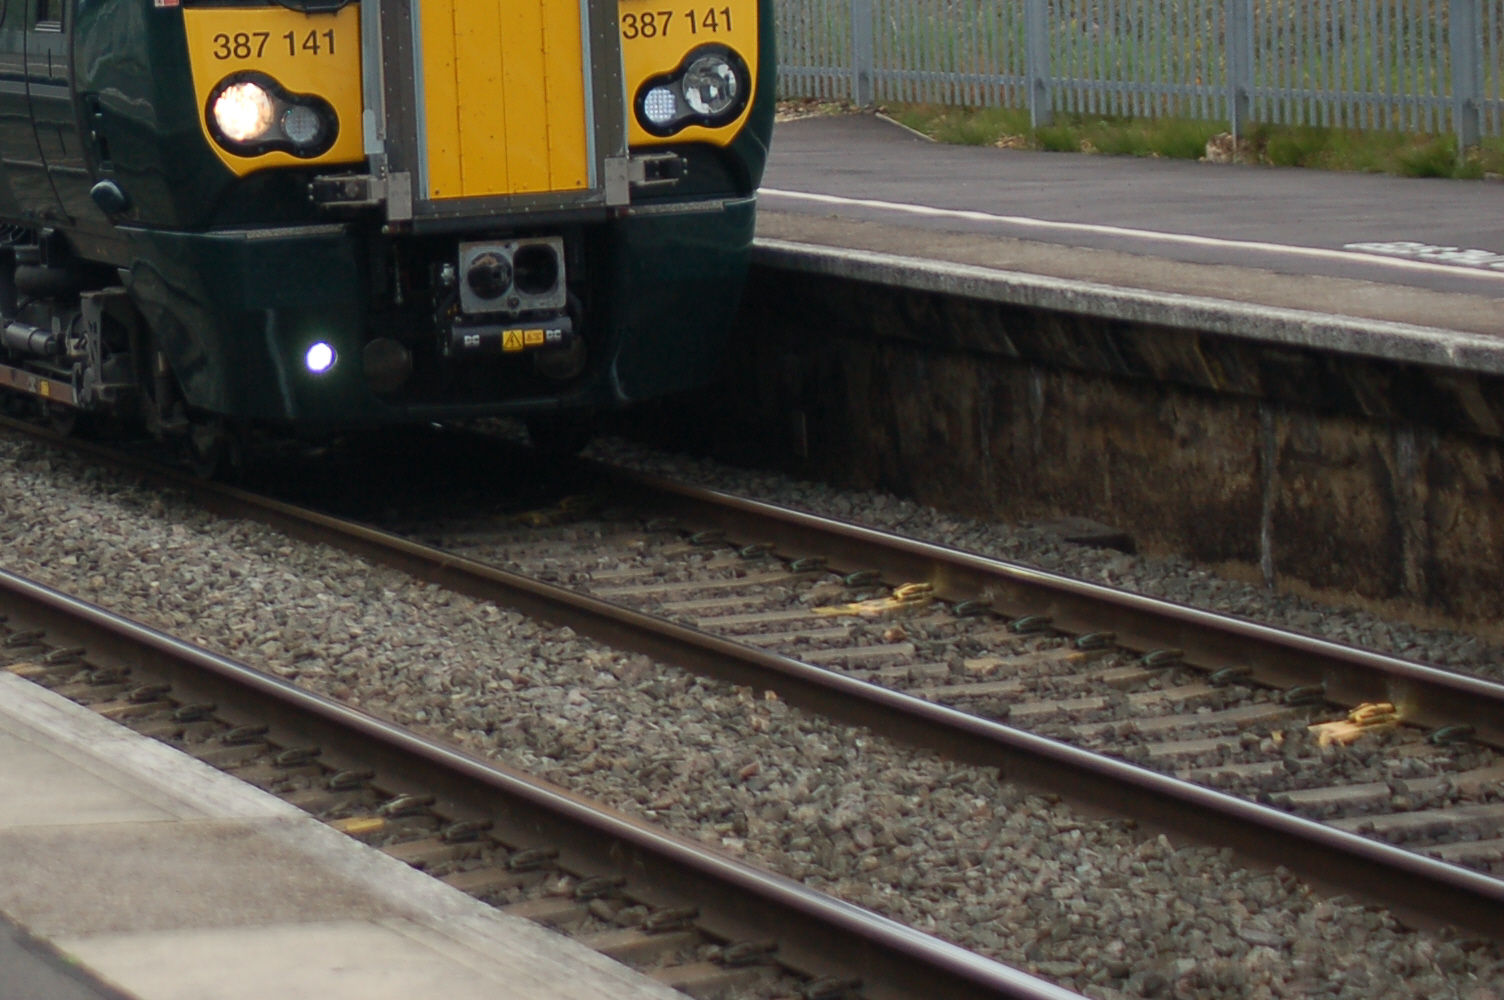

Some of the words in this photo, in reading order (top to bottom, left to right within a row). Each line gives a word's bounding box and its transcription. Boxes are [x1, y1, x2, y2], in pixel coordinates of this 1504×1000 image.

[621, 10, 673, 39] 387
[684, 6, 731, 33] 141
[213, 31, 270, 60] 387
[282, 29, 334, 56] 141
